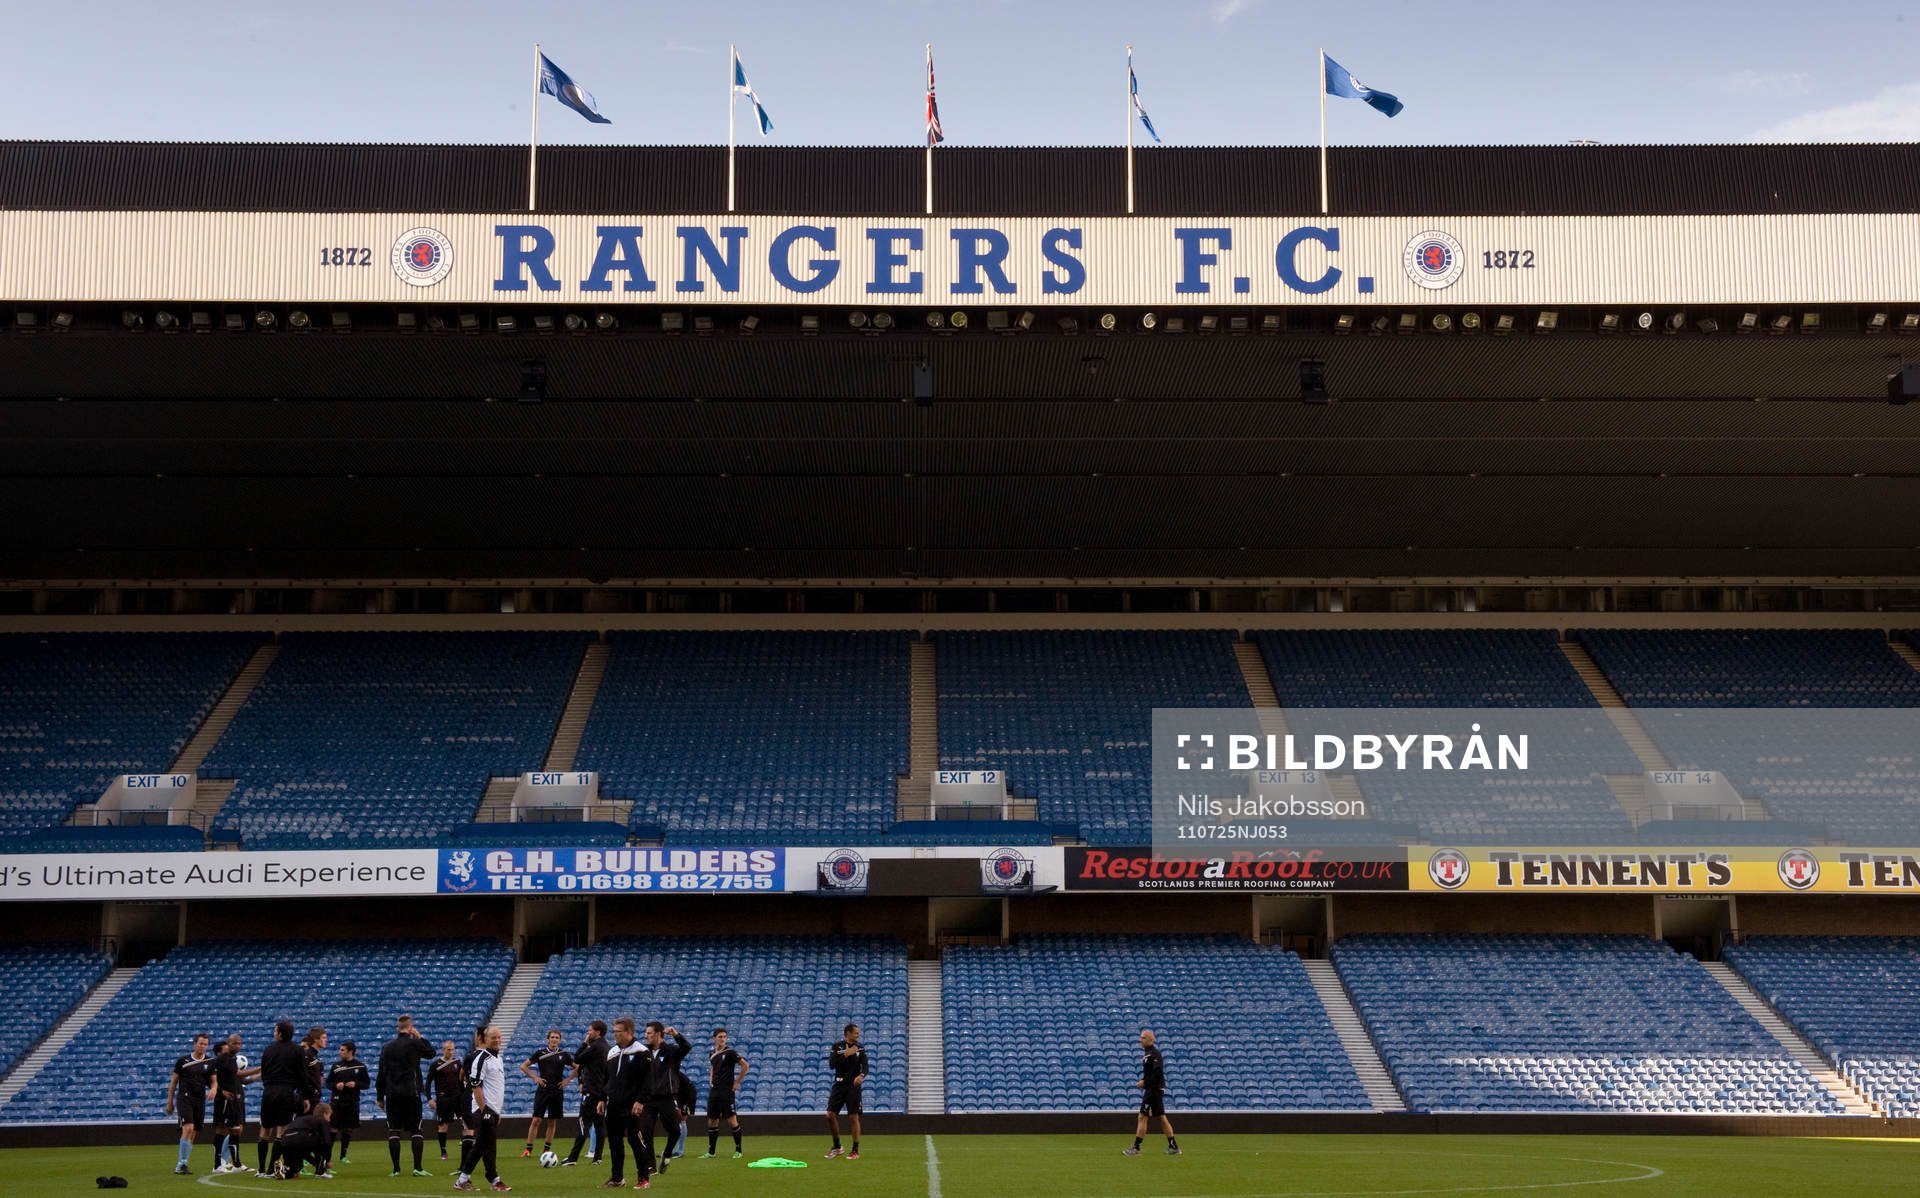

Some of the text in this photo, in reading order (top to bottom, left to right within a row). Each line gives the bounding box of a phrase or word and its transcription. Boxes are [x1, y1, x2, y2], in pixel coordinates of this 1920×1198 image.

[319, 247, 373, 266] 1872
[493, 225, 1374, 295] RANGERS F.C.
[1483, 250, 1535, 268] 1872
[127, 775, 187, 788] EXIT 10
[531, 773, 590, 785] EXIT 11
[939, 772, 996, 783] EXIT 12
[1259, 771, 1316, 783] EXIT 13
[1654, 772, 1711, 784] EXIT 14
[486, 850, 776, 873] G.H. BUILDERS
[1489, 851, 1732, 886] TENNENT'S
[43, 865, 176, 886] Ultimate
[185, 863, 252, 884] Audi
[264, 861, 426, 887] Experience
[488, 873, 774, 890] TEL: 01698 882755
[1138, 880, 1336, 888] SCOTLANDS PREMIER ROOFING COMPANY
